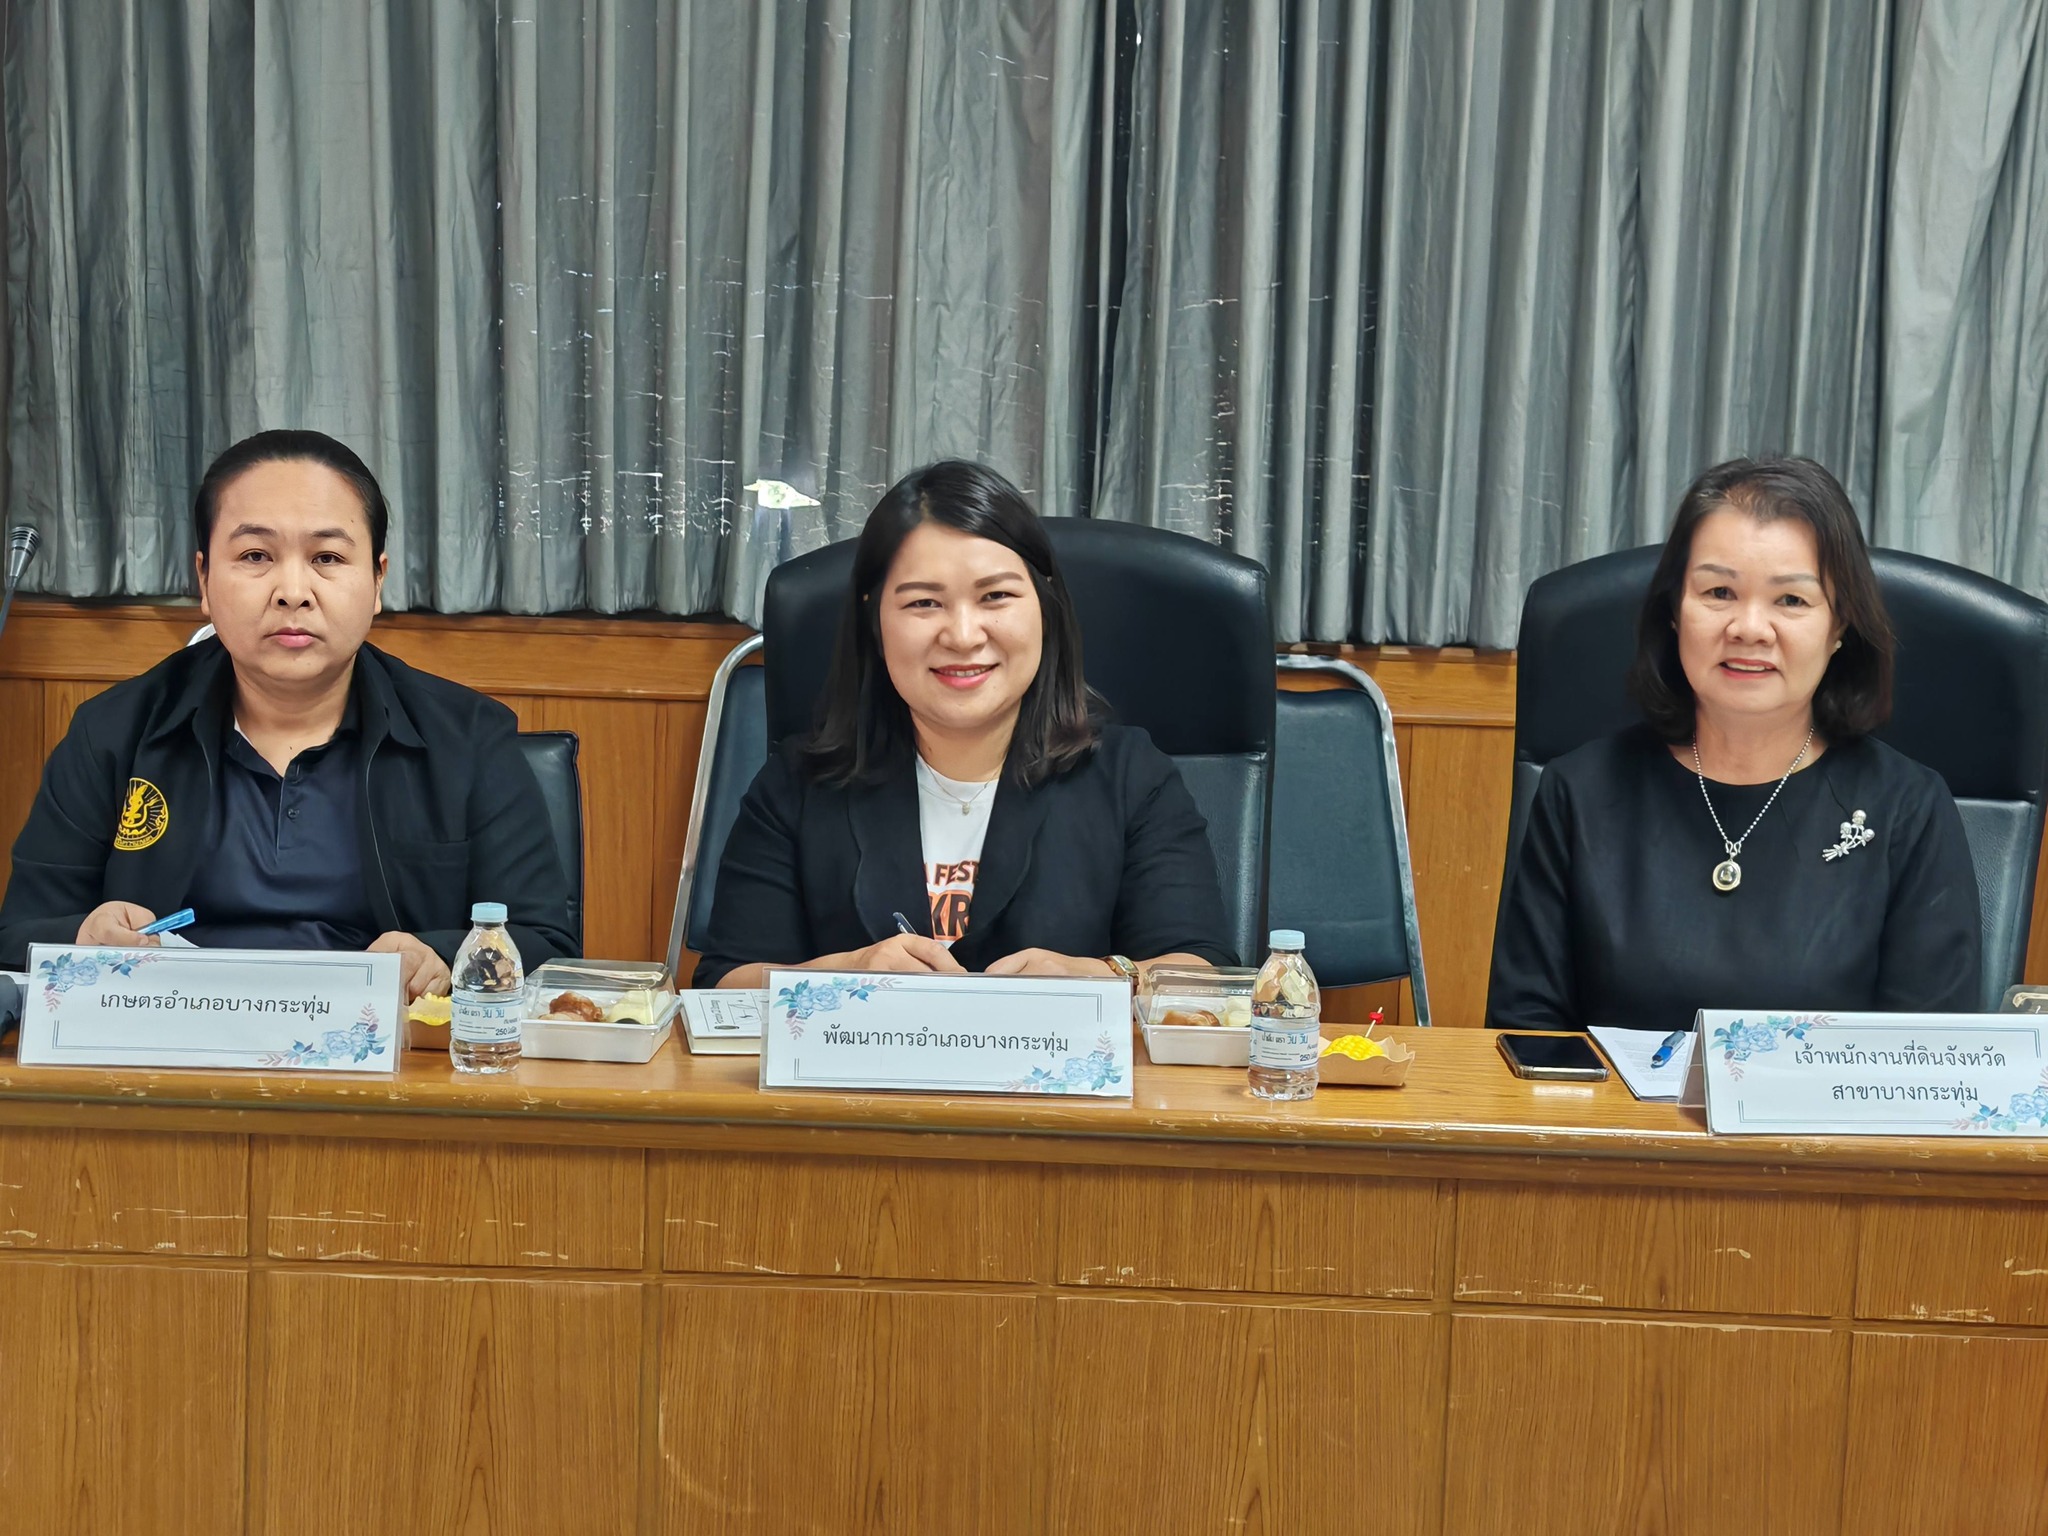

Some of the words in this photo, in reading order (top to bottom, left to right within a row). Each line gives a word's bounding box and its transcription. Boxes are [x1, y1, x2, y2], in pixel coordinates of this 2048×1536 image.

[100, 989, 331, 1021] เกษตรอำเภอบางกระทุ่ม
[823, 1023, 1069, 1058] พัฒนาการอำเภอบางกระทุ่ม
[1795, 1040, 2006, 1067] เจ้าพนักงานที่ดินจังหวัด
[1299, 1053, 1310, 1061] 250
[1832, 1081, 1978, 1108] สาขาบางกระทุ่ม
